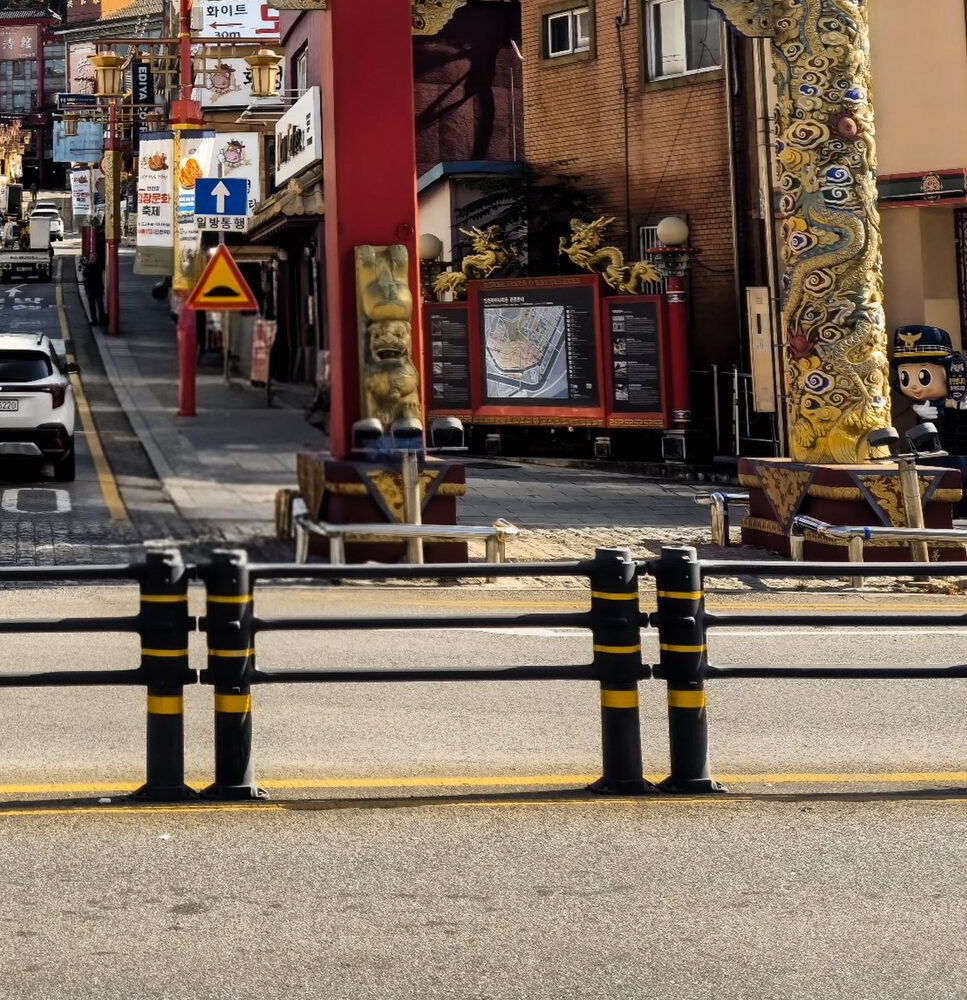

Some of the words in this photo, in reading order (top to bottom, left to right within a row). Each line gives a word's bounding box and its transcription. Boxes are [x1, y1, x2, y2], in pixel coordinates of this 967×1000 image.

[206, 4, 248, 18] 화이트
[138, 66, 148, 100] EDIYA
[196, 217, 245, 229] 일방통행
